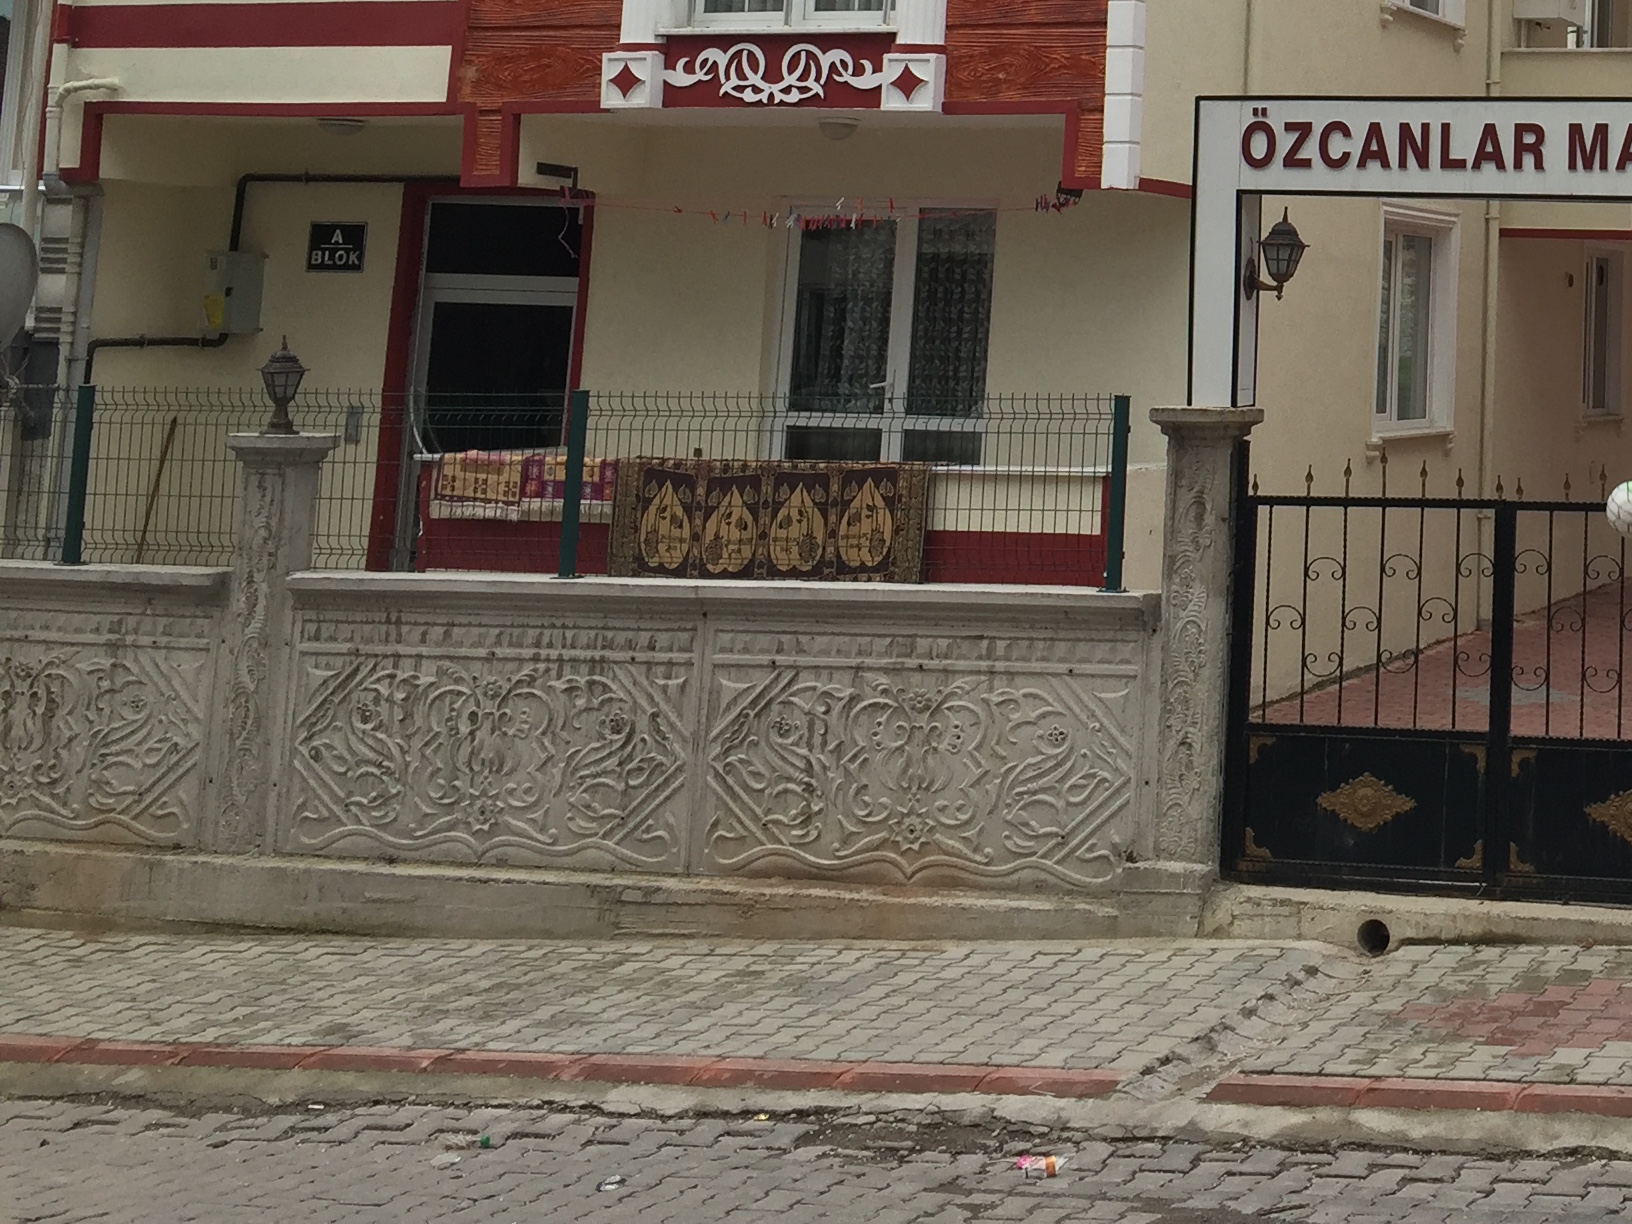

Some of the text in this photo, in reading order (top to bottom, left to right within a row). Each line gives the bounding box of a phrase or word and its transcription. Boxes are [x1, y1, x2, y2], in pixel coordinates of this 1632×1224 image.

[1241, 106, 1546, 171] ÖZCANLAR
[331, 228, 343, 244] A
[311, 249, 360, 265] BLOK
